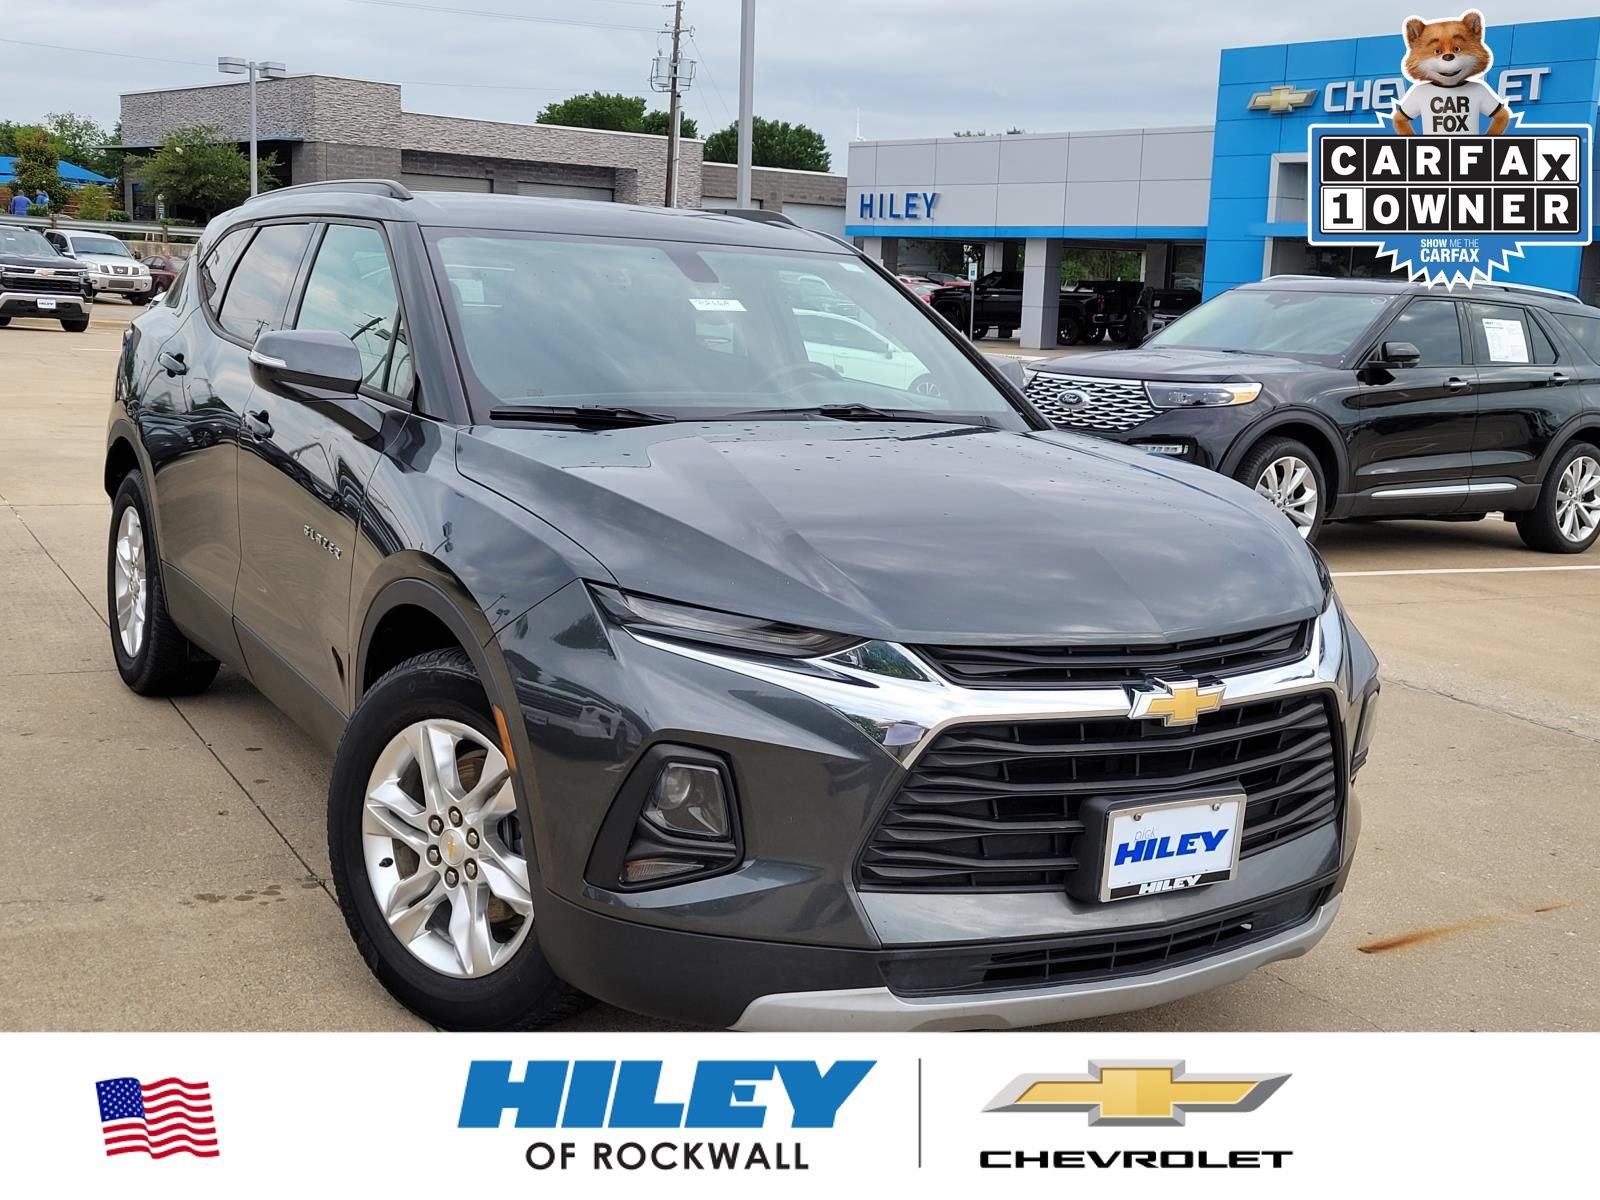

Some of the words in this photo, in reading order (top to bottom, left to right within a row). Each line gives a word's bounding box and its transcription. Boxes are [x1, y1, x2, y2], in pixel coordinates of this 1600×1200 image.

[1324, 67, 1551, 112] CHEET
[859, 192, 937, 219] HILEY
[1114, 828, 1229, 866] HILEY
[1138, 874, 1202, 895] HILEY
